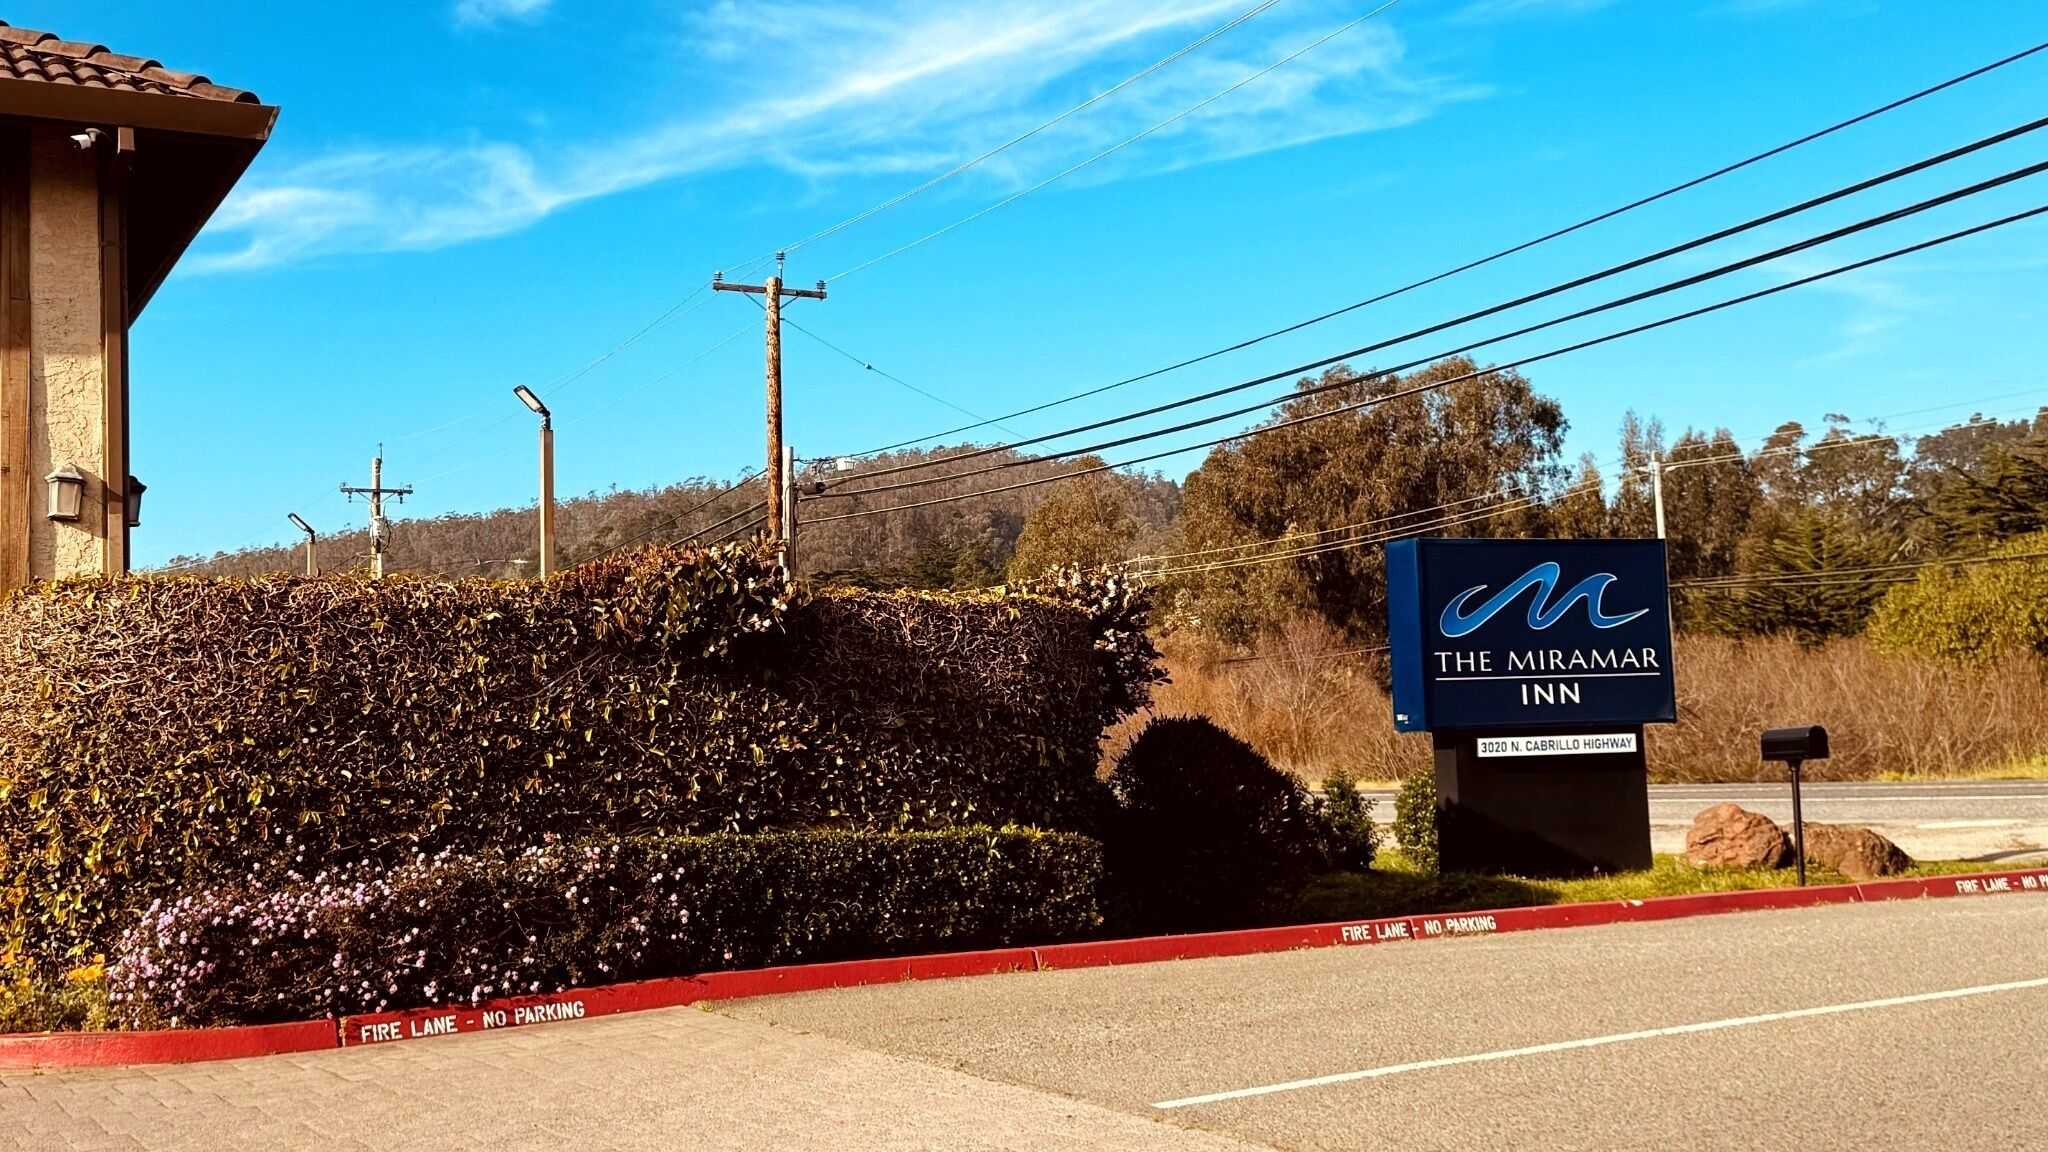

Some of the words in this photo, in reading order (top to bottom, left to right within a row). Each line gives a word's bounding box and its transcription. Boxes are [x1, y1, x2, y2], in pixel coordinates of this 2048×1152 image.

[1434, 651, 1492, 672] THE
[1507, 647, 1660, 671] MIRAMAR
[1521, 682, 1581, 705] INN
[1481, 741, 1507, 753] 3020
[1511, 740, 1523, 752] N.
[1525, 739, 1580, 751] CABRILLO
[1583, 737, 1633, 750] HIGHWAY
[1955, 879, 1979, 893] FIRE
[1982, 877, 2012, 892] LANE
[2021, 875, 2038, 889] NO
[1341, 924, 1372, 942] FIRE
[1376, 922, 1409, 939] LANE
[1424, 919, 1443, 935] NO
[1446, 915, 1497, 933] PARKING
[361, 1022, 402, 1043] FIRE
[411, 1015, 458, 1037] LANE
[483, 1011, 507, 1029] NO
[515, 1000, 585, 1024] PARKING
